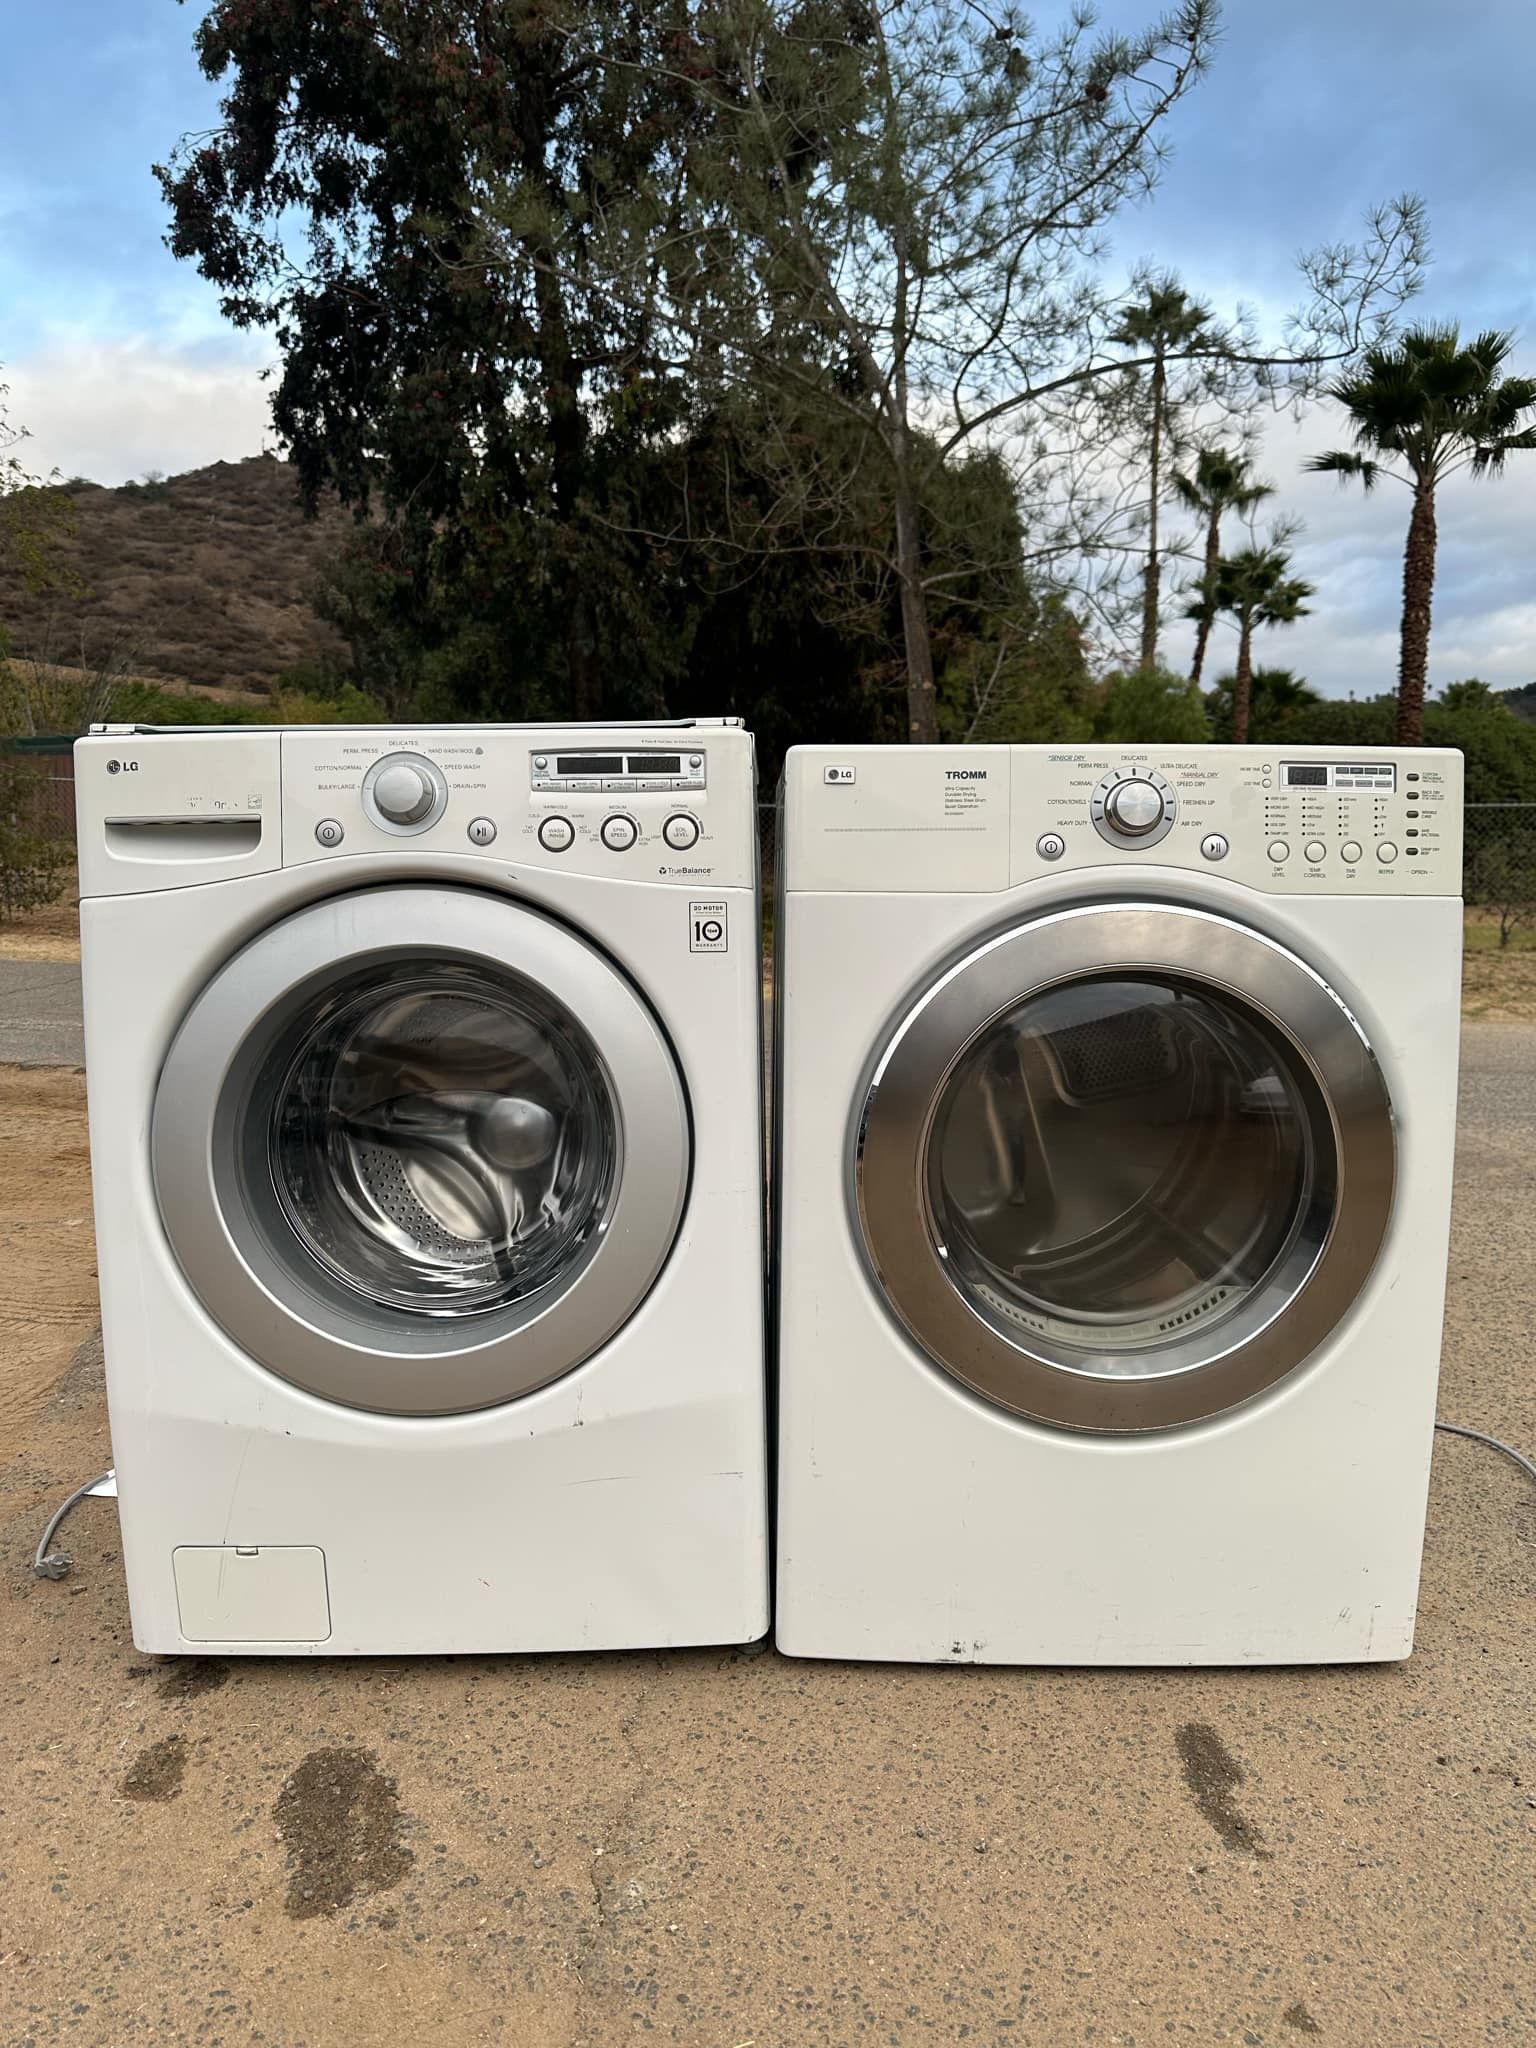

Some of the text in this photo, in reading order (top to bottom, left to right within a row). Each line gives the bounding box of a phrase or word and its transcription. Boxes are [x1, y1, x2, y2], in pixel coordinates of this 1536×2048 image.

[123, 761, 139, 772] LG
[841, 770, 852, 778] LG
[944, 770, 987, 780] TROMM
[694, 920, 723, 941] 10
